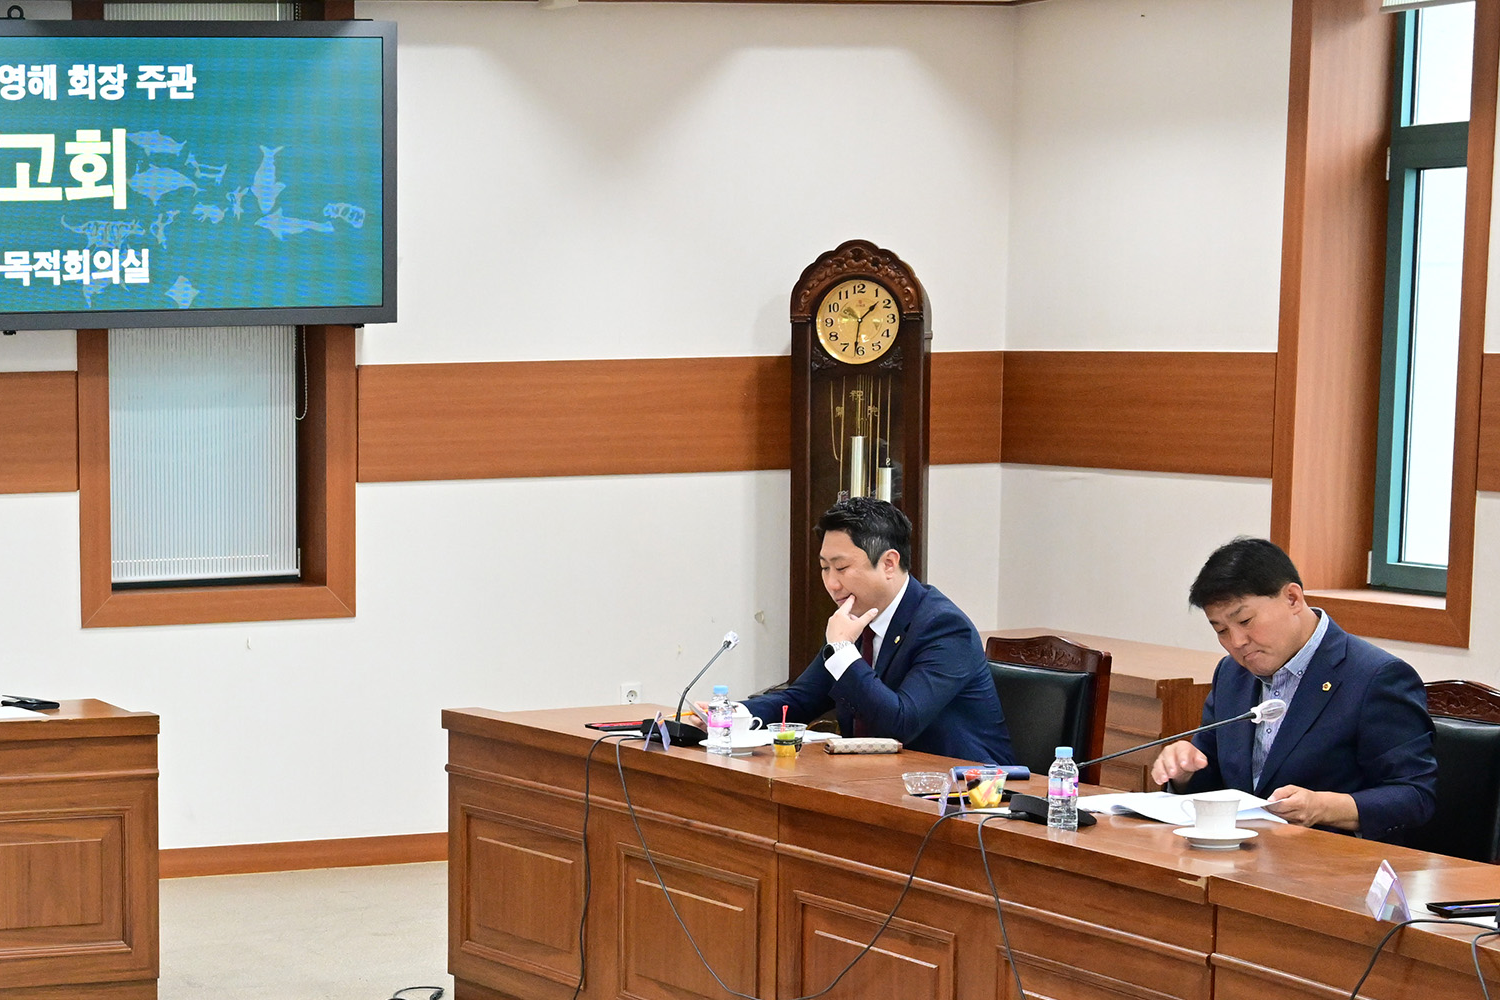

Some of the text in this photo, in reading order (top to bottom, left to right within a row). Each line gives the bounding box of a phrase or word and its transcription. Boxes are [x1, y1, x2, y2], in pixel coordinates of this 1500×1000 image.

[67, 63, 128, 101] 회장
[136, 63, 197, 100] 주관
[853, 284, 866, 294] 12
[839, 290, 848, 300] 11
[828, 303, 839, 312] 10
[883, 299, 892, 308] 2
[825, 318, 834, 327] 9
[887, 314, 896, 324] 3
[829, 332, 838, 341] 8
[882, 329, 891, 338] 4
[840, 343, 849, 352] 7
[872, 341, 881, 351] 5
[857, 346, 865, 356] 6
